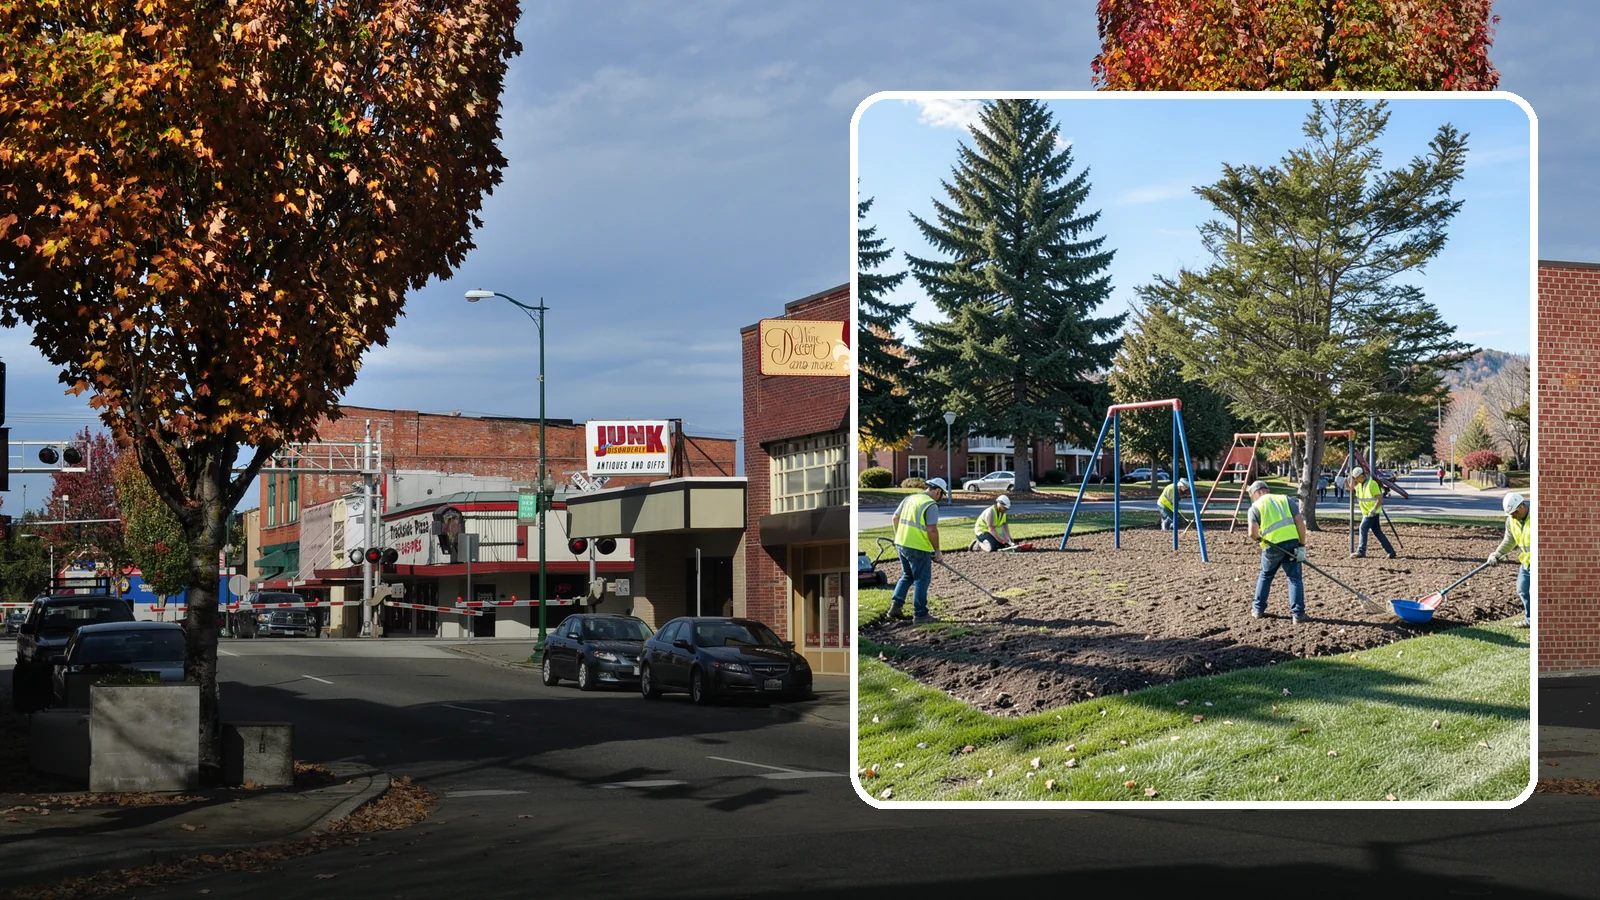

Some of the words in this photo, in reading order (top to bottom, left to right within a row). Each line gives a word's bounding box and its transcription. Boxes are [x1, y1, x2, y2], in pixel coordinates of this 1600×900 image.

[765, 327, 831, 365] Decor
[596, 425, 665, 456] JUNK
[607, 446, 646, 454] DISORDERLY
[596, 461, 628, 470] ANTIQUES
[631, 461, 644, 470] AND
[646, 460, 666, 469] GIFTS
[352, 498, 365, 511] CRO
[414, 519, 429, 535] Pizza
